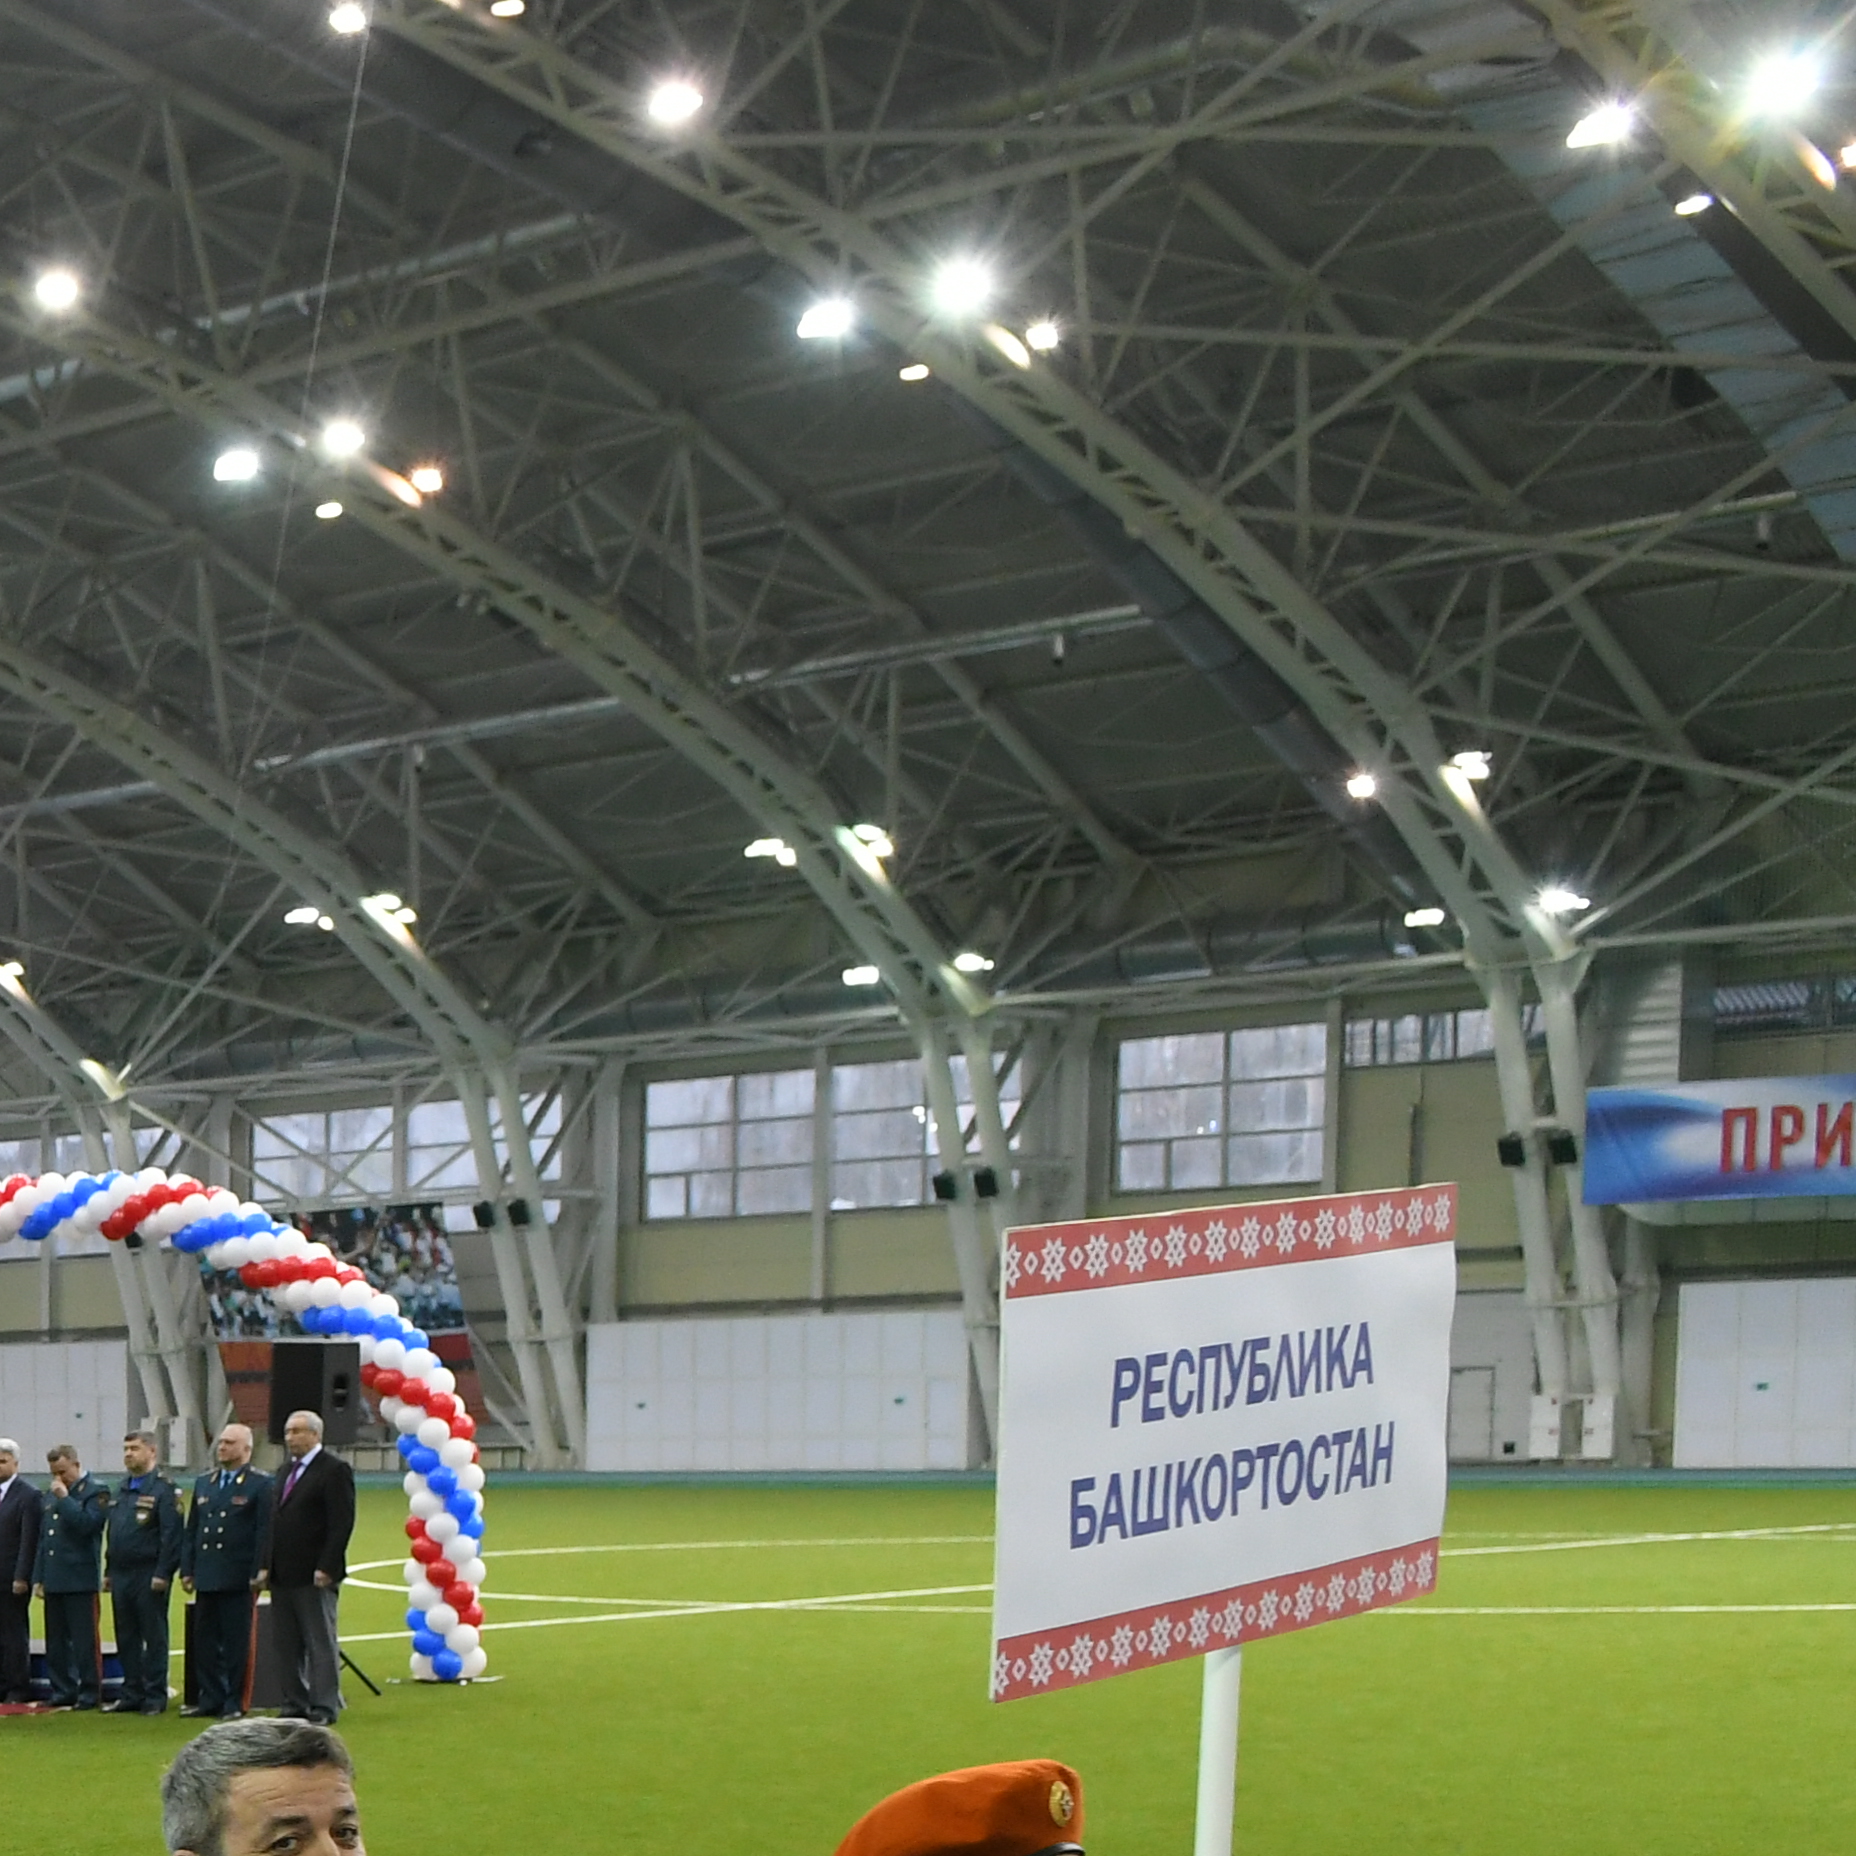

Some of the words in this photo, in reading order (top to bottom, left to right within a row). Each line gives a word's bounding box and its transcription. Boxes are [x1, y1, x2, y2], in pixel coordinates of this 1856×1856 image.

[1719, 1102, 1855, 1173] ПРИ
[1110, 1321, 1374, 1429] РЕСПУБЛИКА
[1069, 1421, 1395, 1550] БАШКОРТОСТАН
